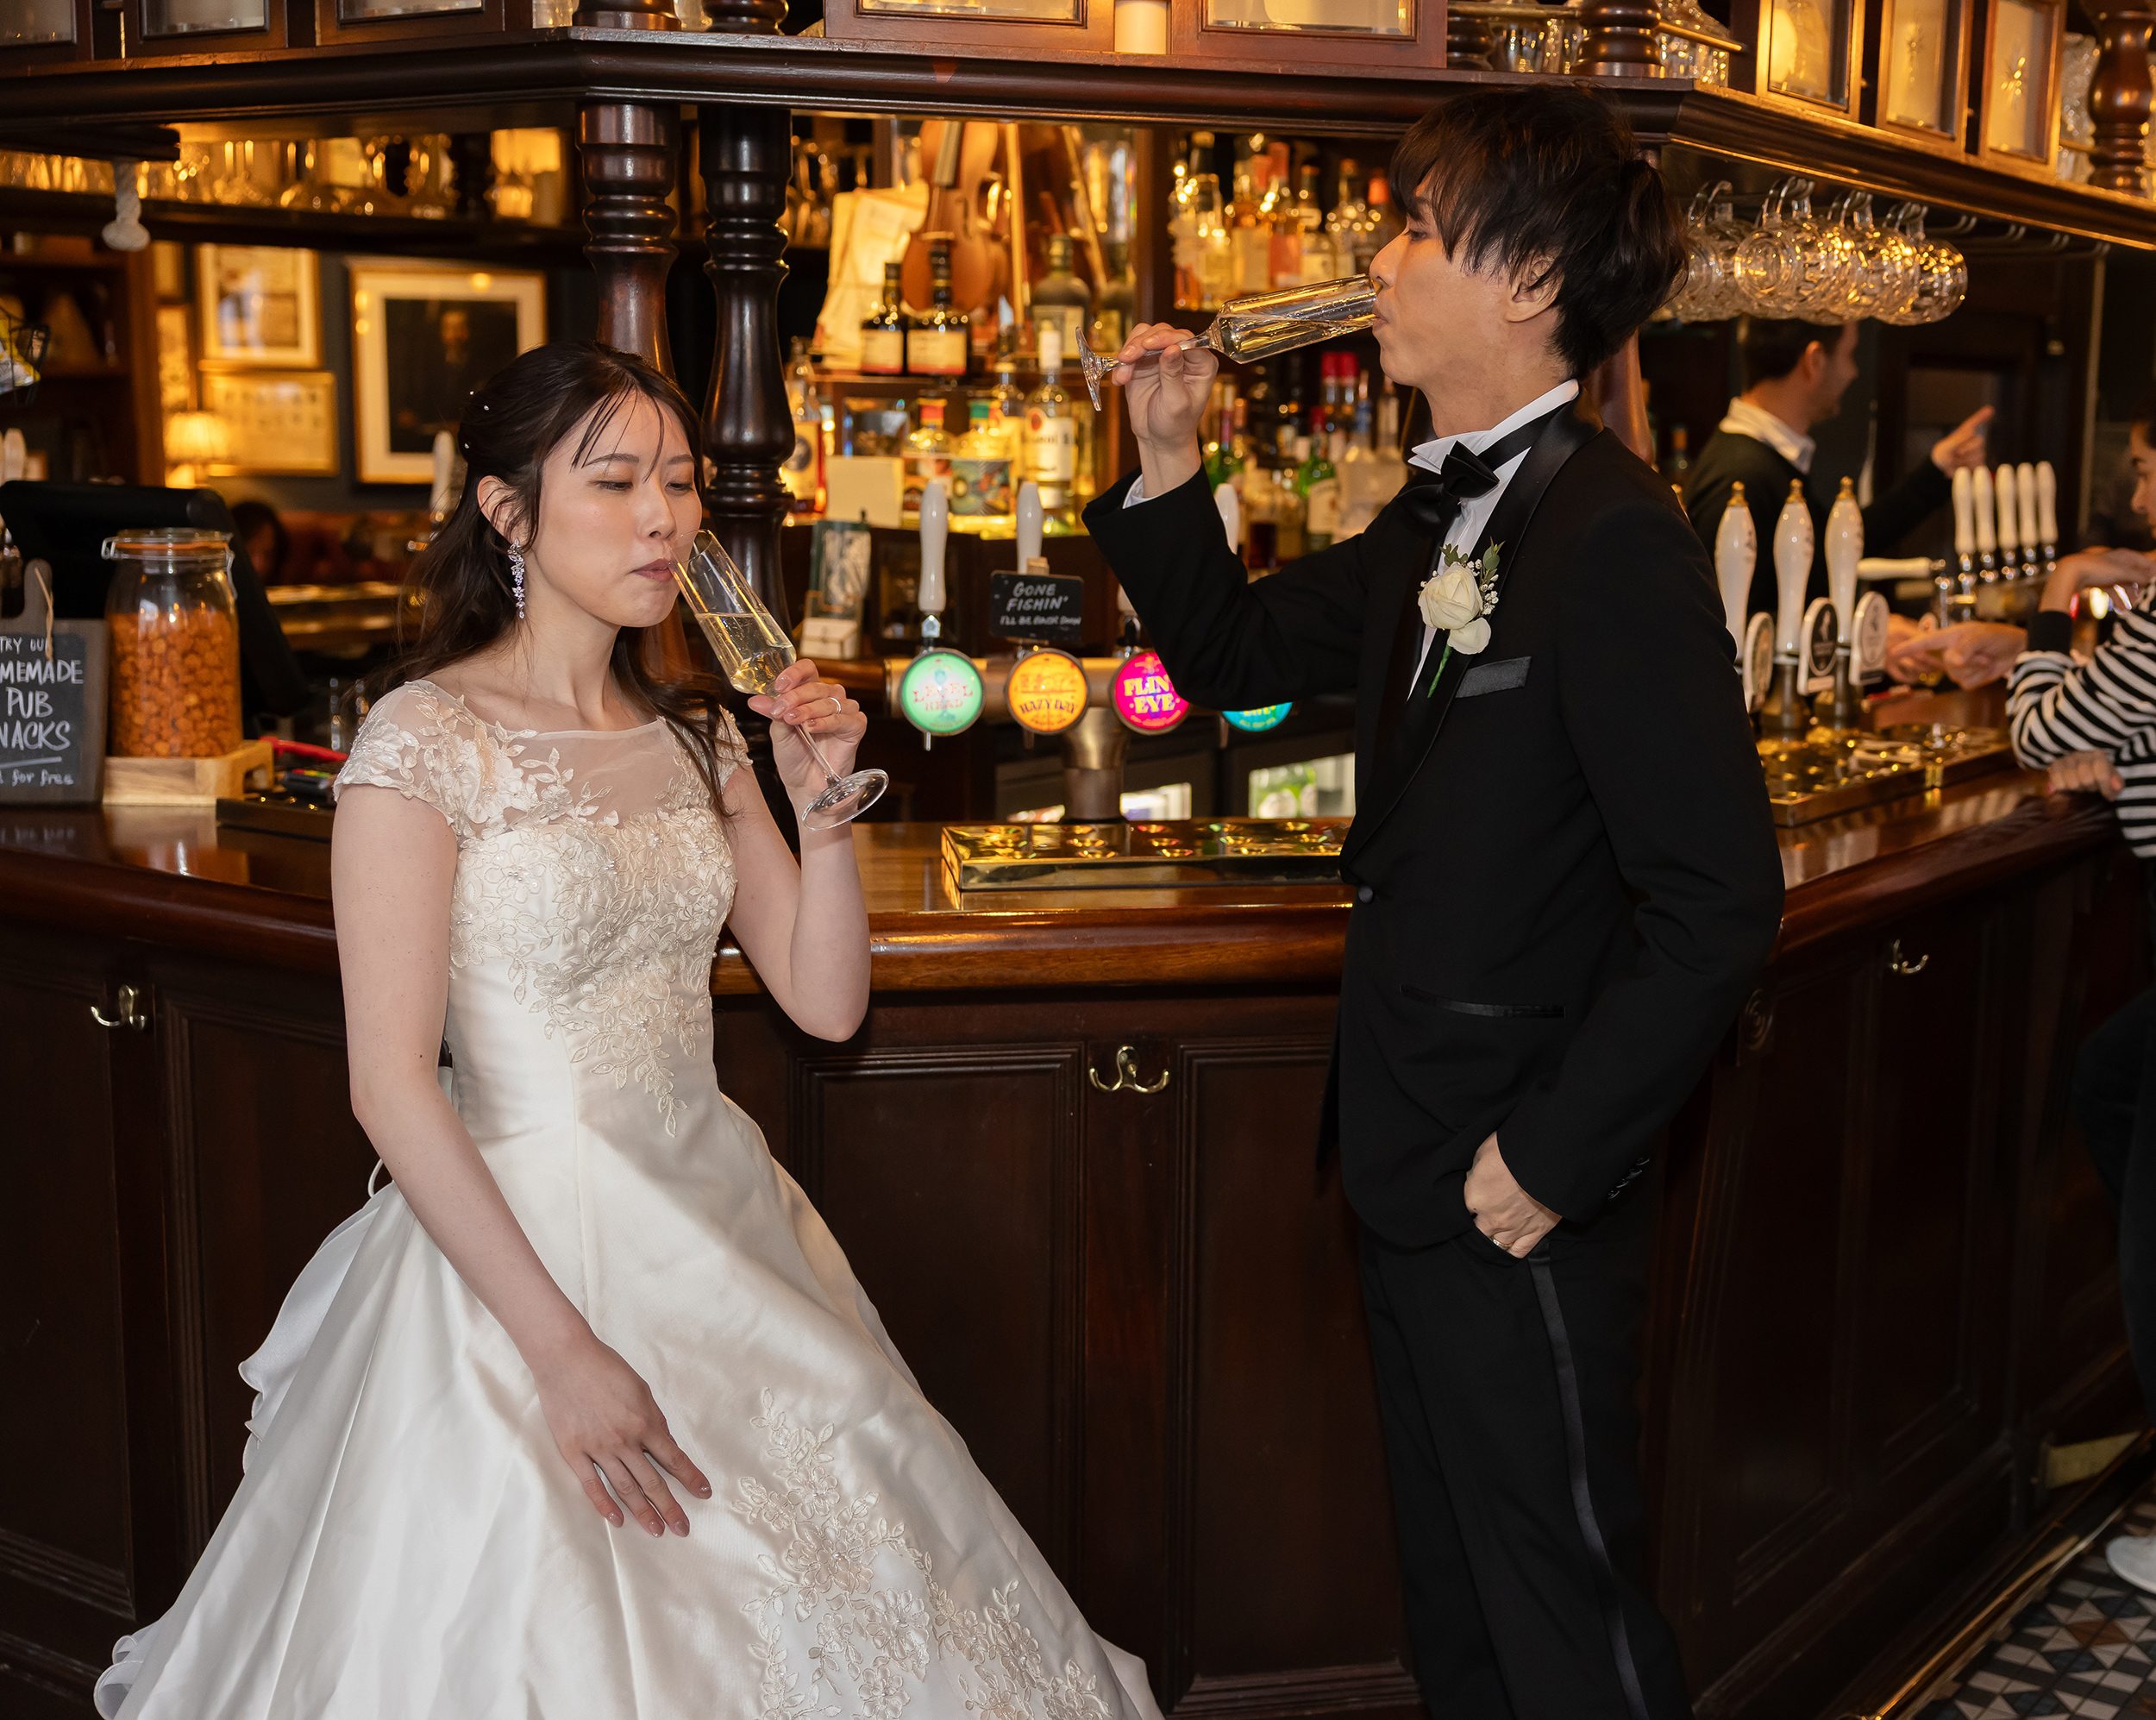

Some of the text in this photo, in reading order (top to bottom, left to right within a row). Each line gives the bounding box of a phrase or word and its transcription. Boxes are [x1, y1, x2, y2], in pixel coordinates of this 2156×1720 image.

[1012, 581, 1056, 598] GONE
[0, 636, 22, 655] TRY
[6, 687, 53, 719] PUB
[1133, 694, 1175, 714] EYE
